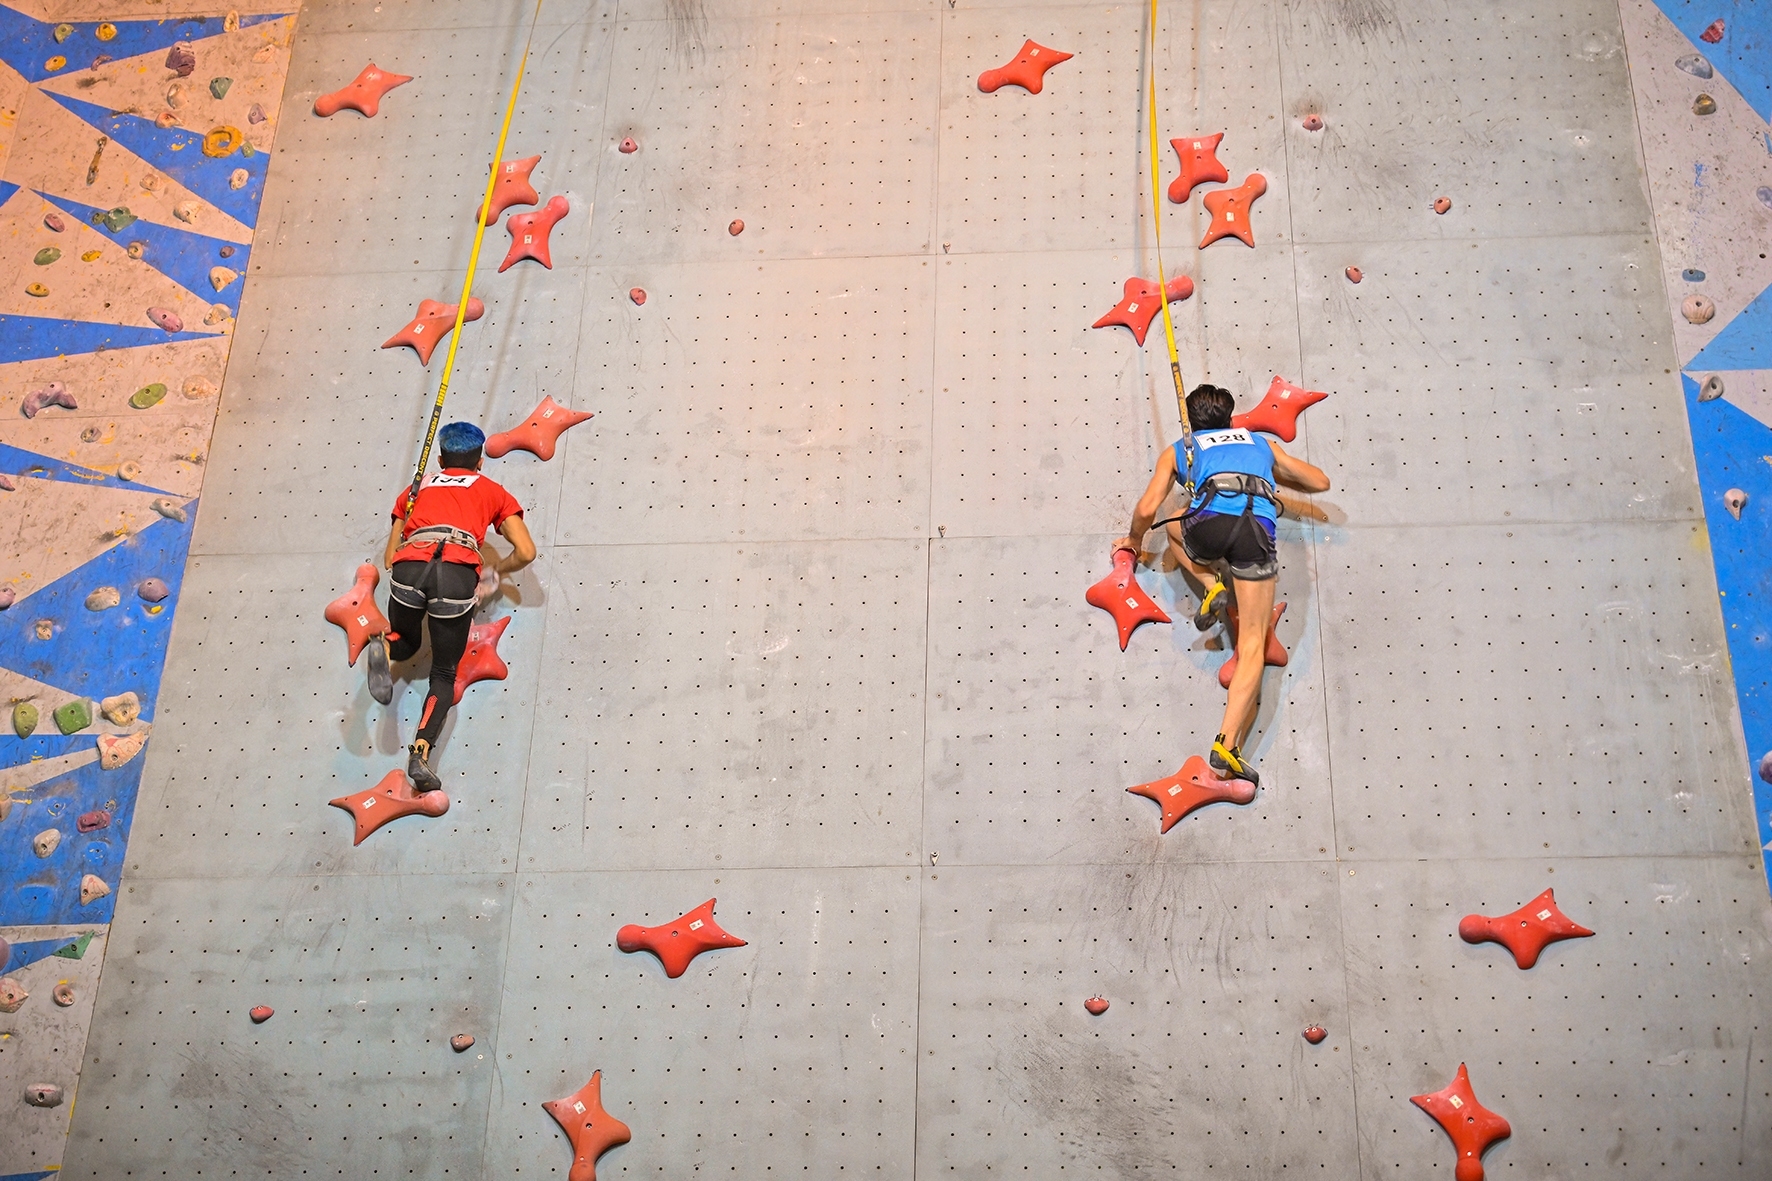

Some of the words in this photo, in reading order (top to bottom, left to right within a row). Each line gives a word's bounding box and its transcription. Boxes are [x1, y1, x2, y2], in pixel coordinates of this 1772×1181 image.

[427, 416, 438, 445] PERFECT
[1206, 434, 1246, 443] 128
[418, 445, 430, 475] DESCENT
